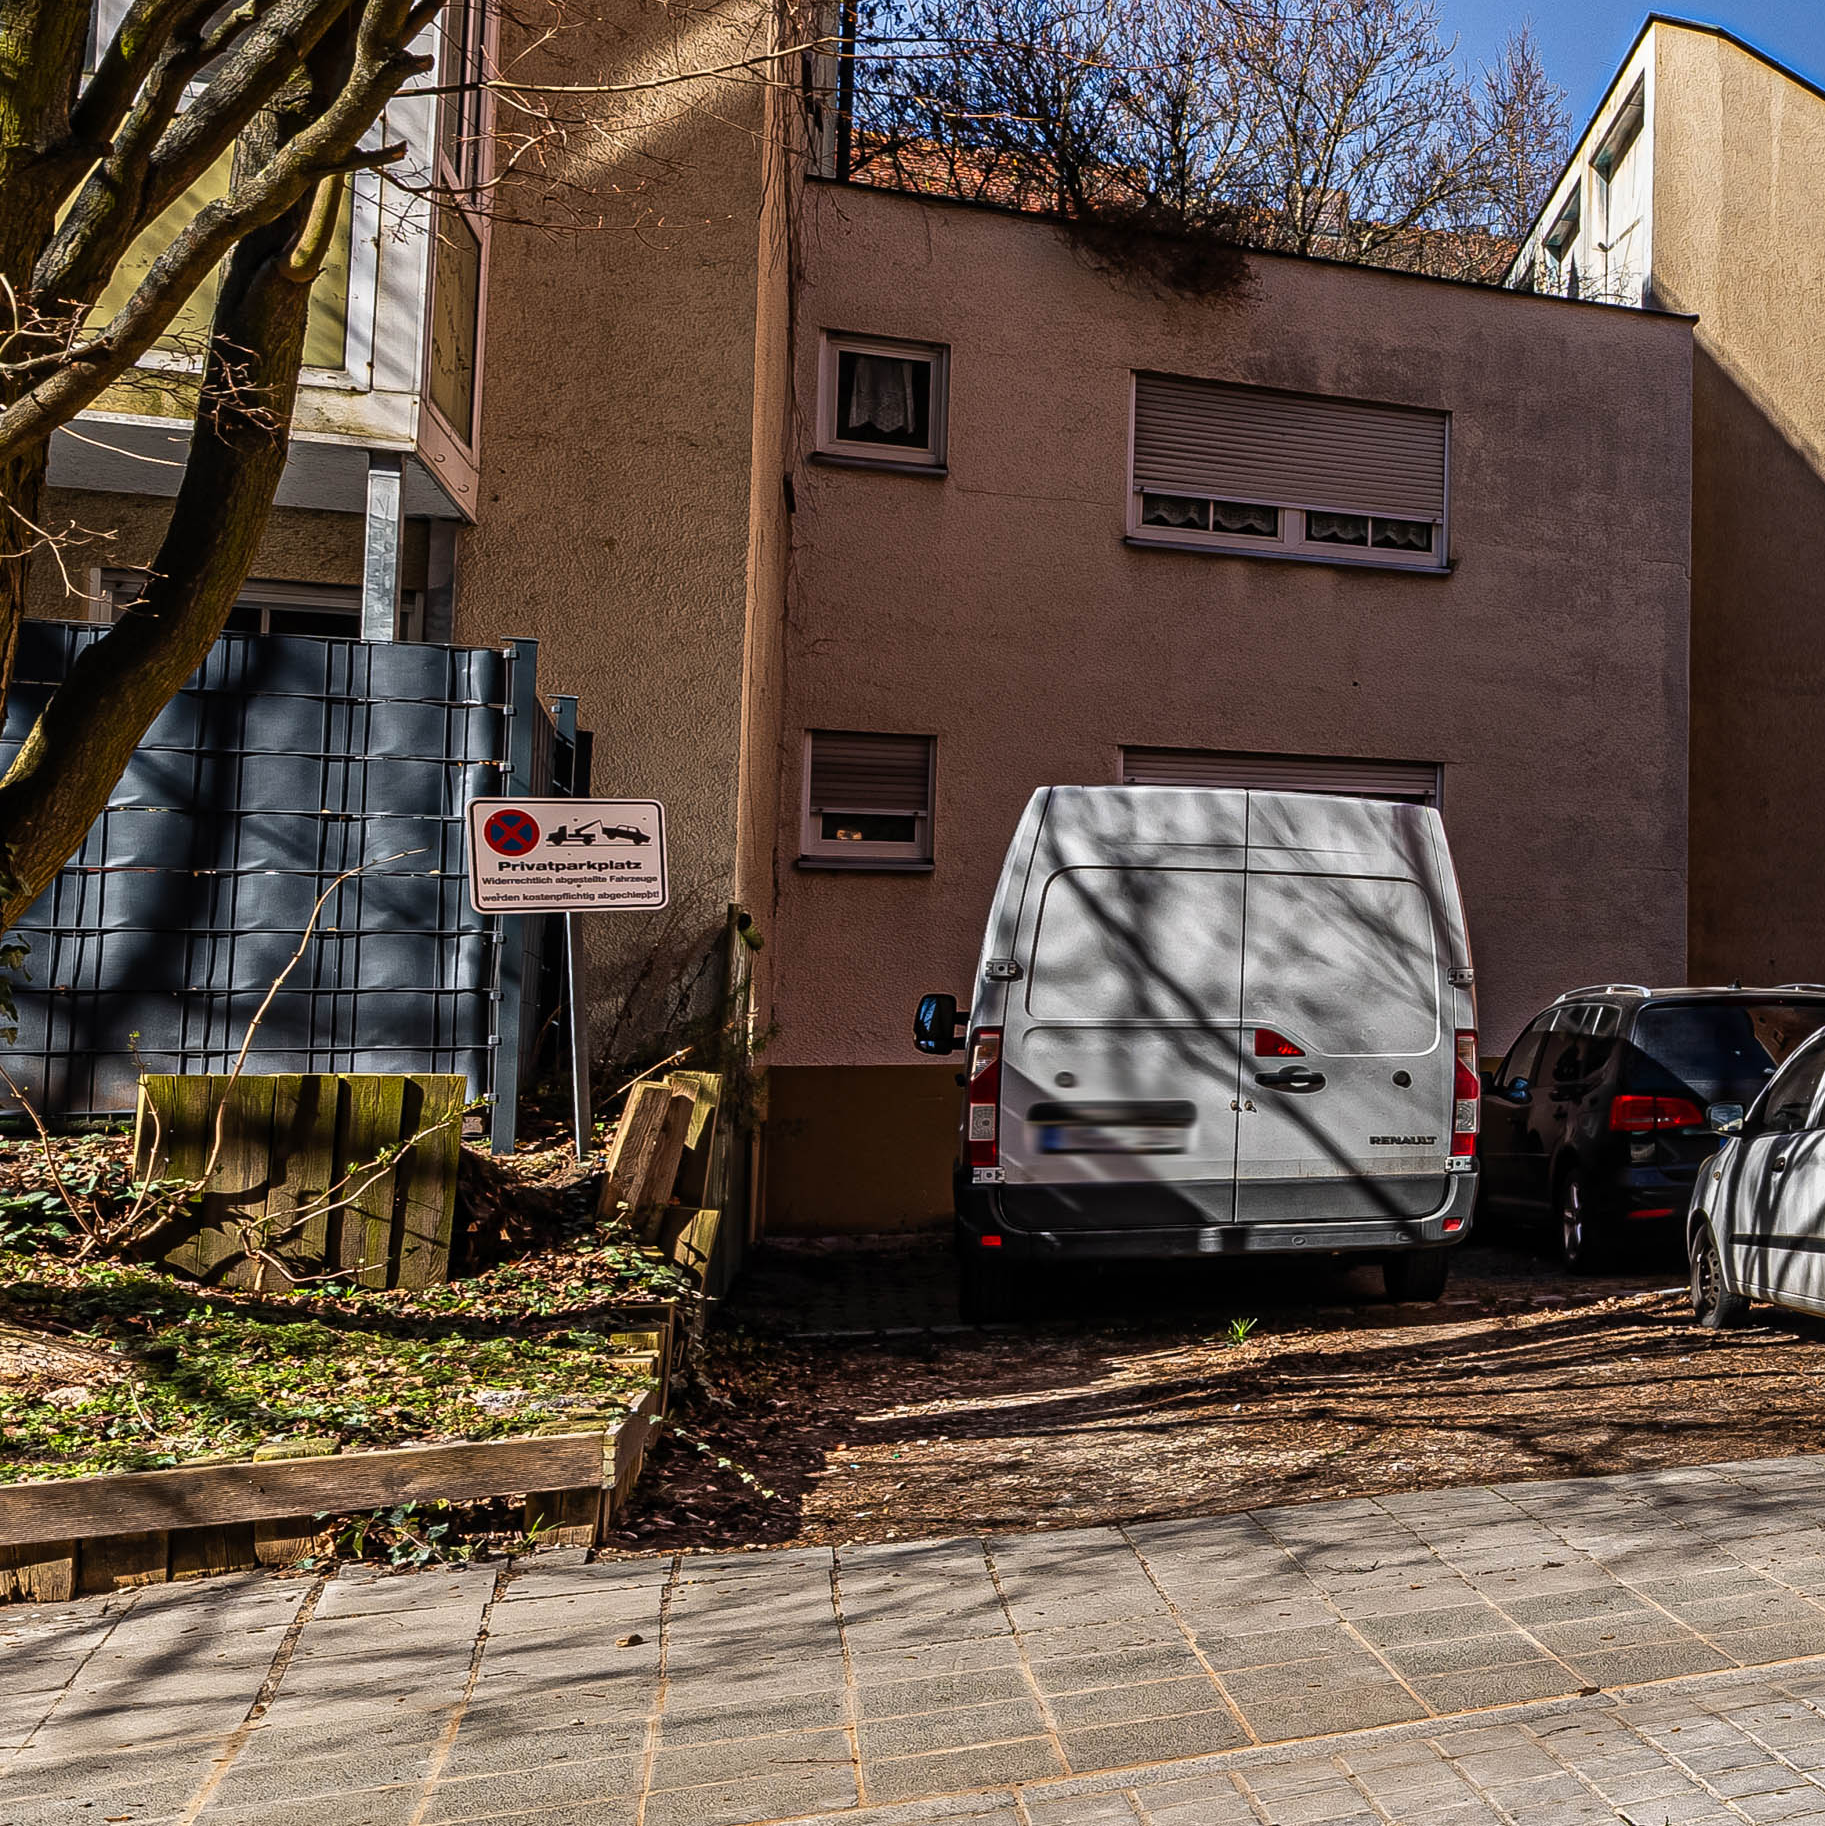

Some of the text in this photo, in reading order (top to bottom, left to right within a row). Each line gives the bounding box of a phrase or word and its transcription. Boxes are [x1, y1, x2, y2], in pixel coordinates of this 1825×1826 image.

[497, 860, 643, 873] Privatparkplatz
[481, 875, 658, 885] Widerrechtlich abgestellte Fahrzeuge
[481, 892, 520, 902] werden
[522, 891, 596, 902] kostenpflichtig
[1369, 1135, 1438, 1145] RENAULT
